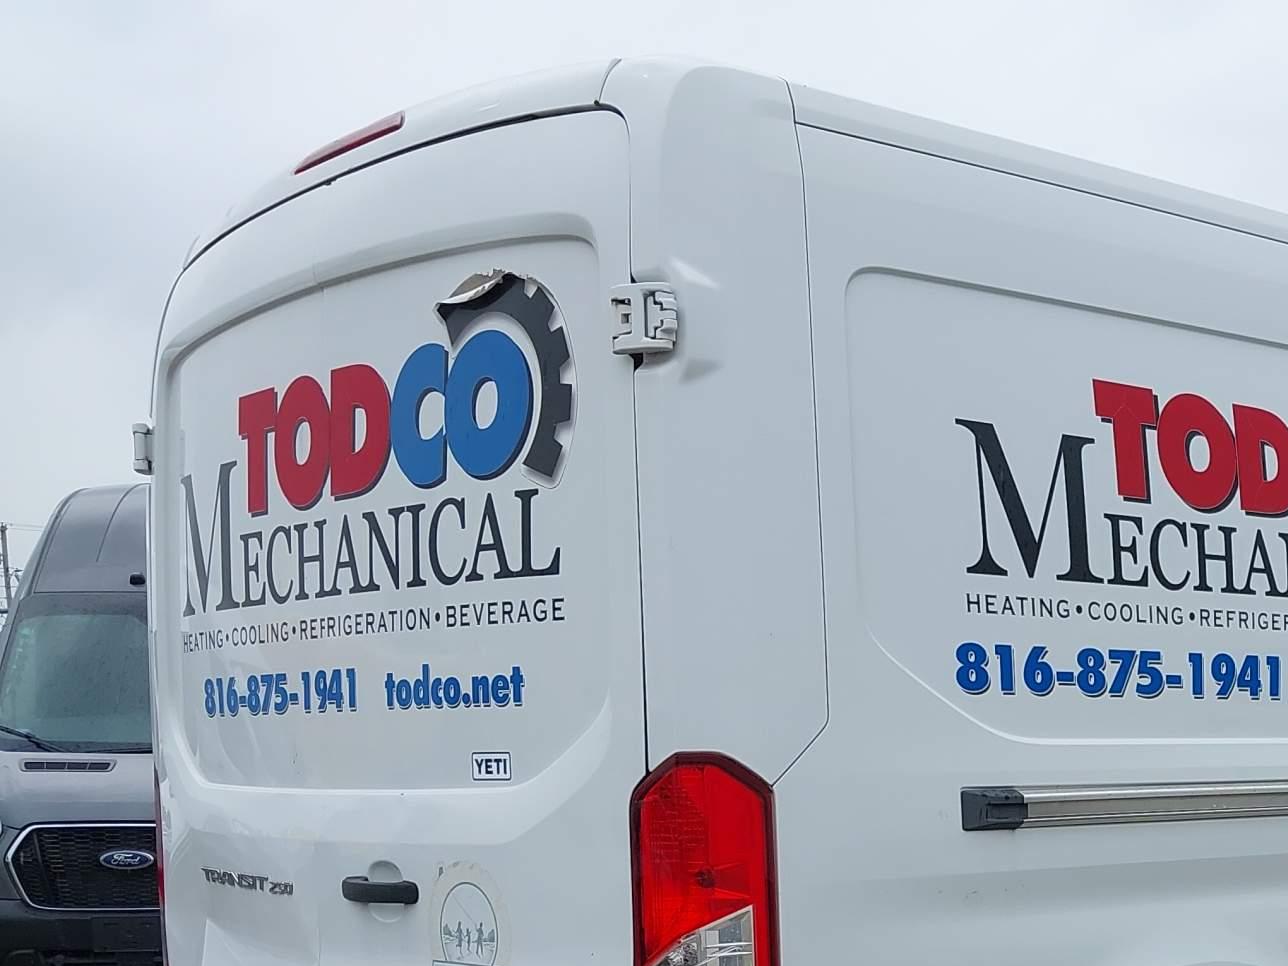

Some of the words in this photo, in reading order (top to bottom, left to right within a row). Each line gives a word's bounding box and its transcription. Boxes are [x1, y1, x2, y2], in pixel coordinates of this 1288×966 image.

[238, 330, 533, 518] TODCO
[181, 460, 562, 617] MECHANICAL
[183, 629, 224, 653] HEATING
[231, 622, 289, 646] COOLING
[300, 607, 431, 641] REFRIGERATION
[446, 597, 566, 627] BEVERAGE
[966, 593, 1071, 620] HEATING
[1088, 601, 1184, 625] COOLING
[204, 667, 358, 718] 816-875-1941
[384, 663, 526, 710] todco.net
[955, 642, 1282, 699] 816-875-1941
[475, 756, 508, 776] YETI
[200, 867, 269, 892] TRANSIT
